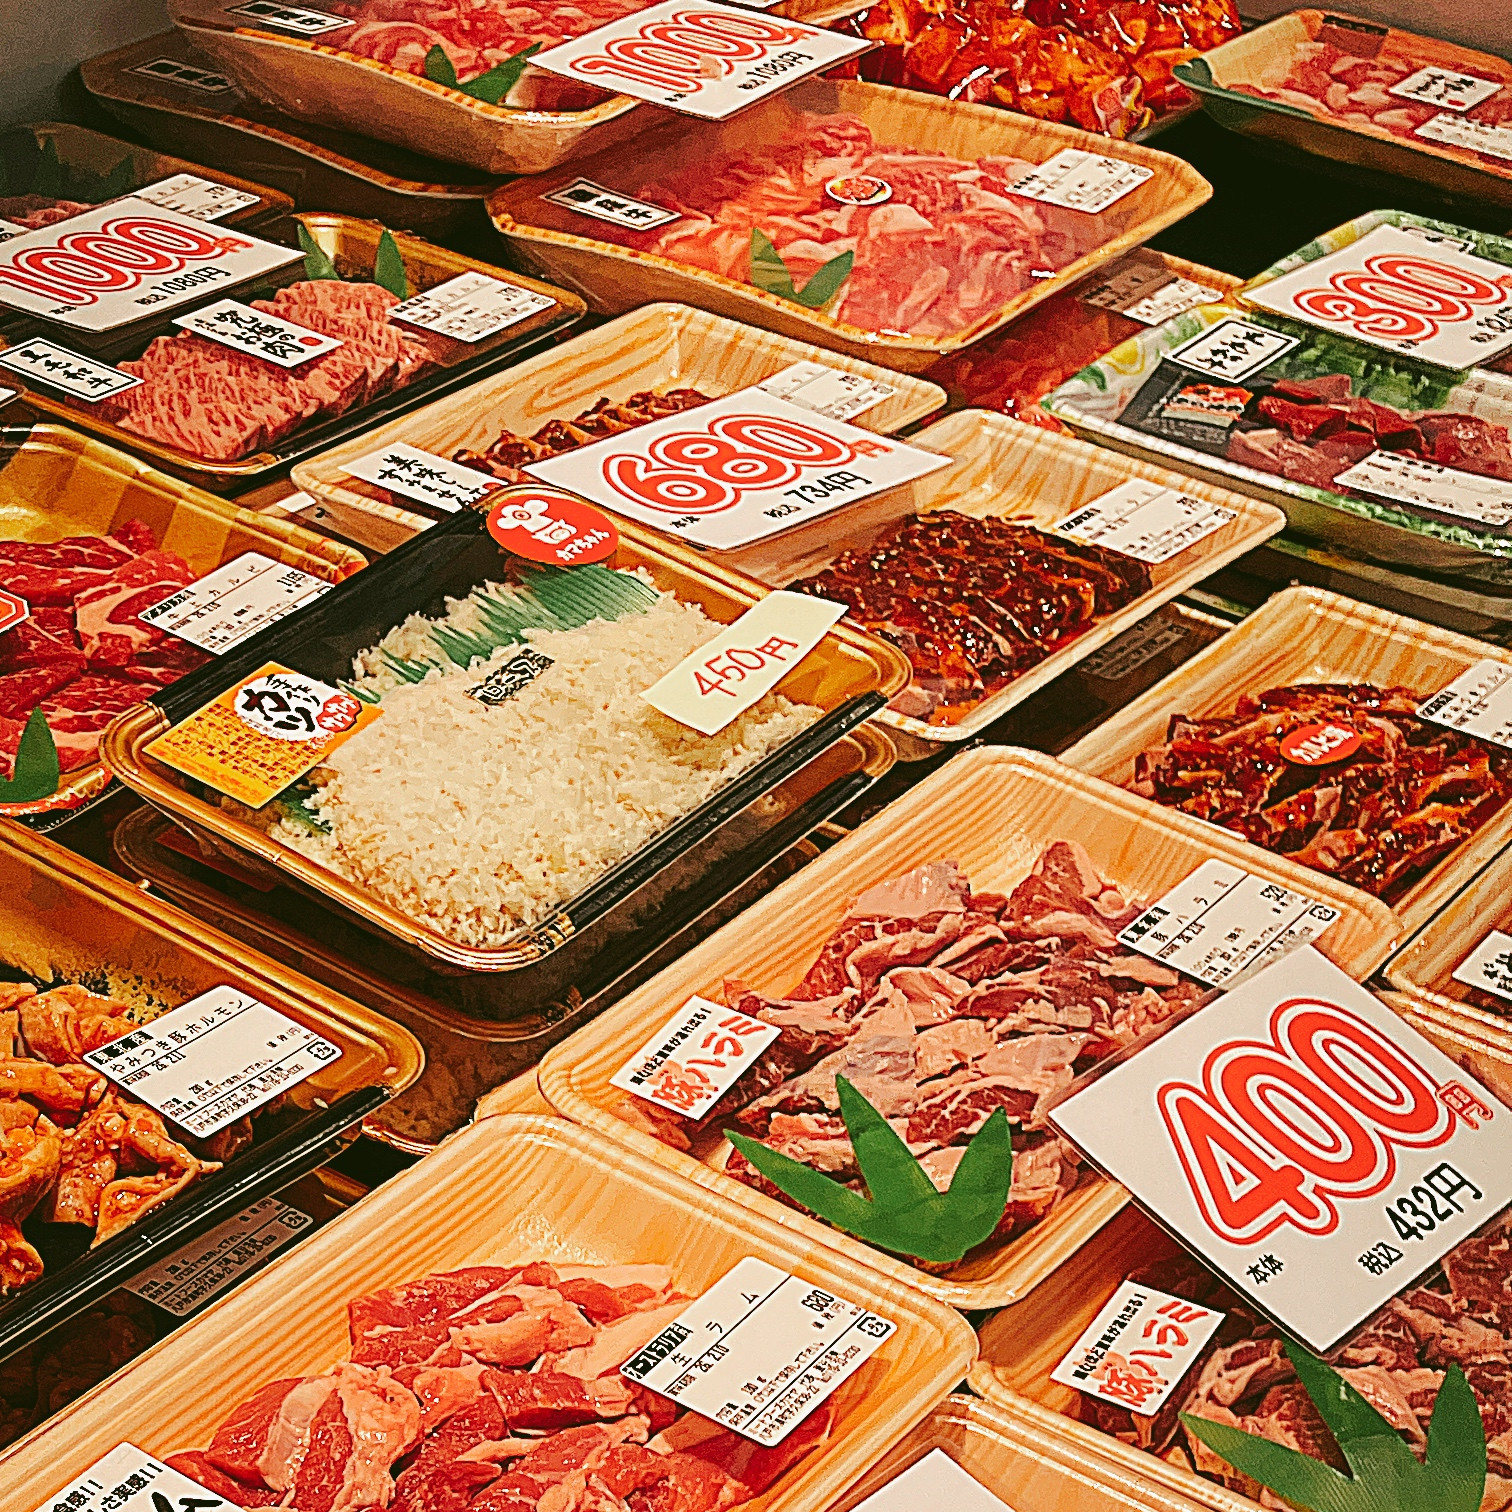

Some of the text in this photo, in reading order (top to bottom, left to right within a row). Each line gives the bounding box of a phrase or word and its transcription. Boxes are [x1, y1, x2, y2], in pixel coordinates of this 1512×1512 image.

[796, 471, 873, 505] 734円
[555, 528, 611, 561] カマちゃん
[692, 636, 799, 700] 450円
[92, 1030, 153, 1064] 東北産
[108, 998, 249, 1075] やみつき豚ホルモン
[649, 1011, 768, 1111] 豚ハラミ
[1358, 1163, 1483, 1277] 税込 432円
[1246, 1254, 1284, 1285] 本体
[666, 1289, 762, 1367] 生ラム
[1094, 1297, 1211, 1408] 豚ハラミ
